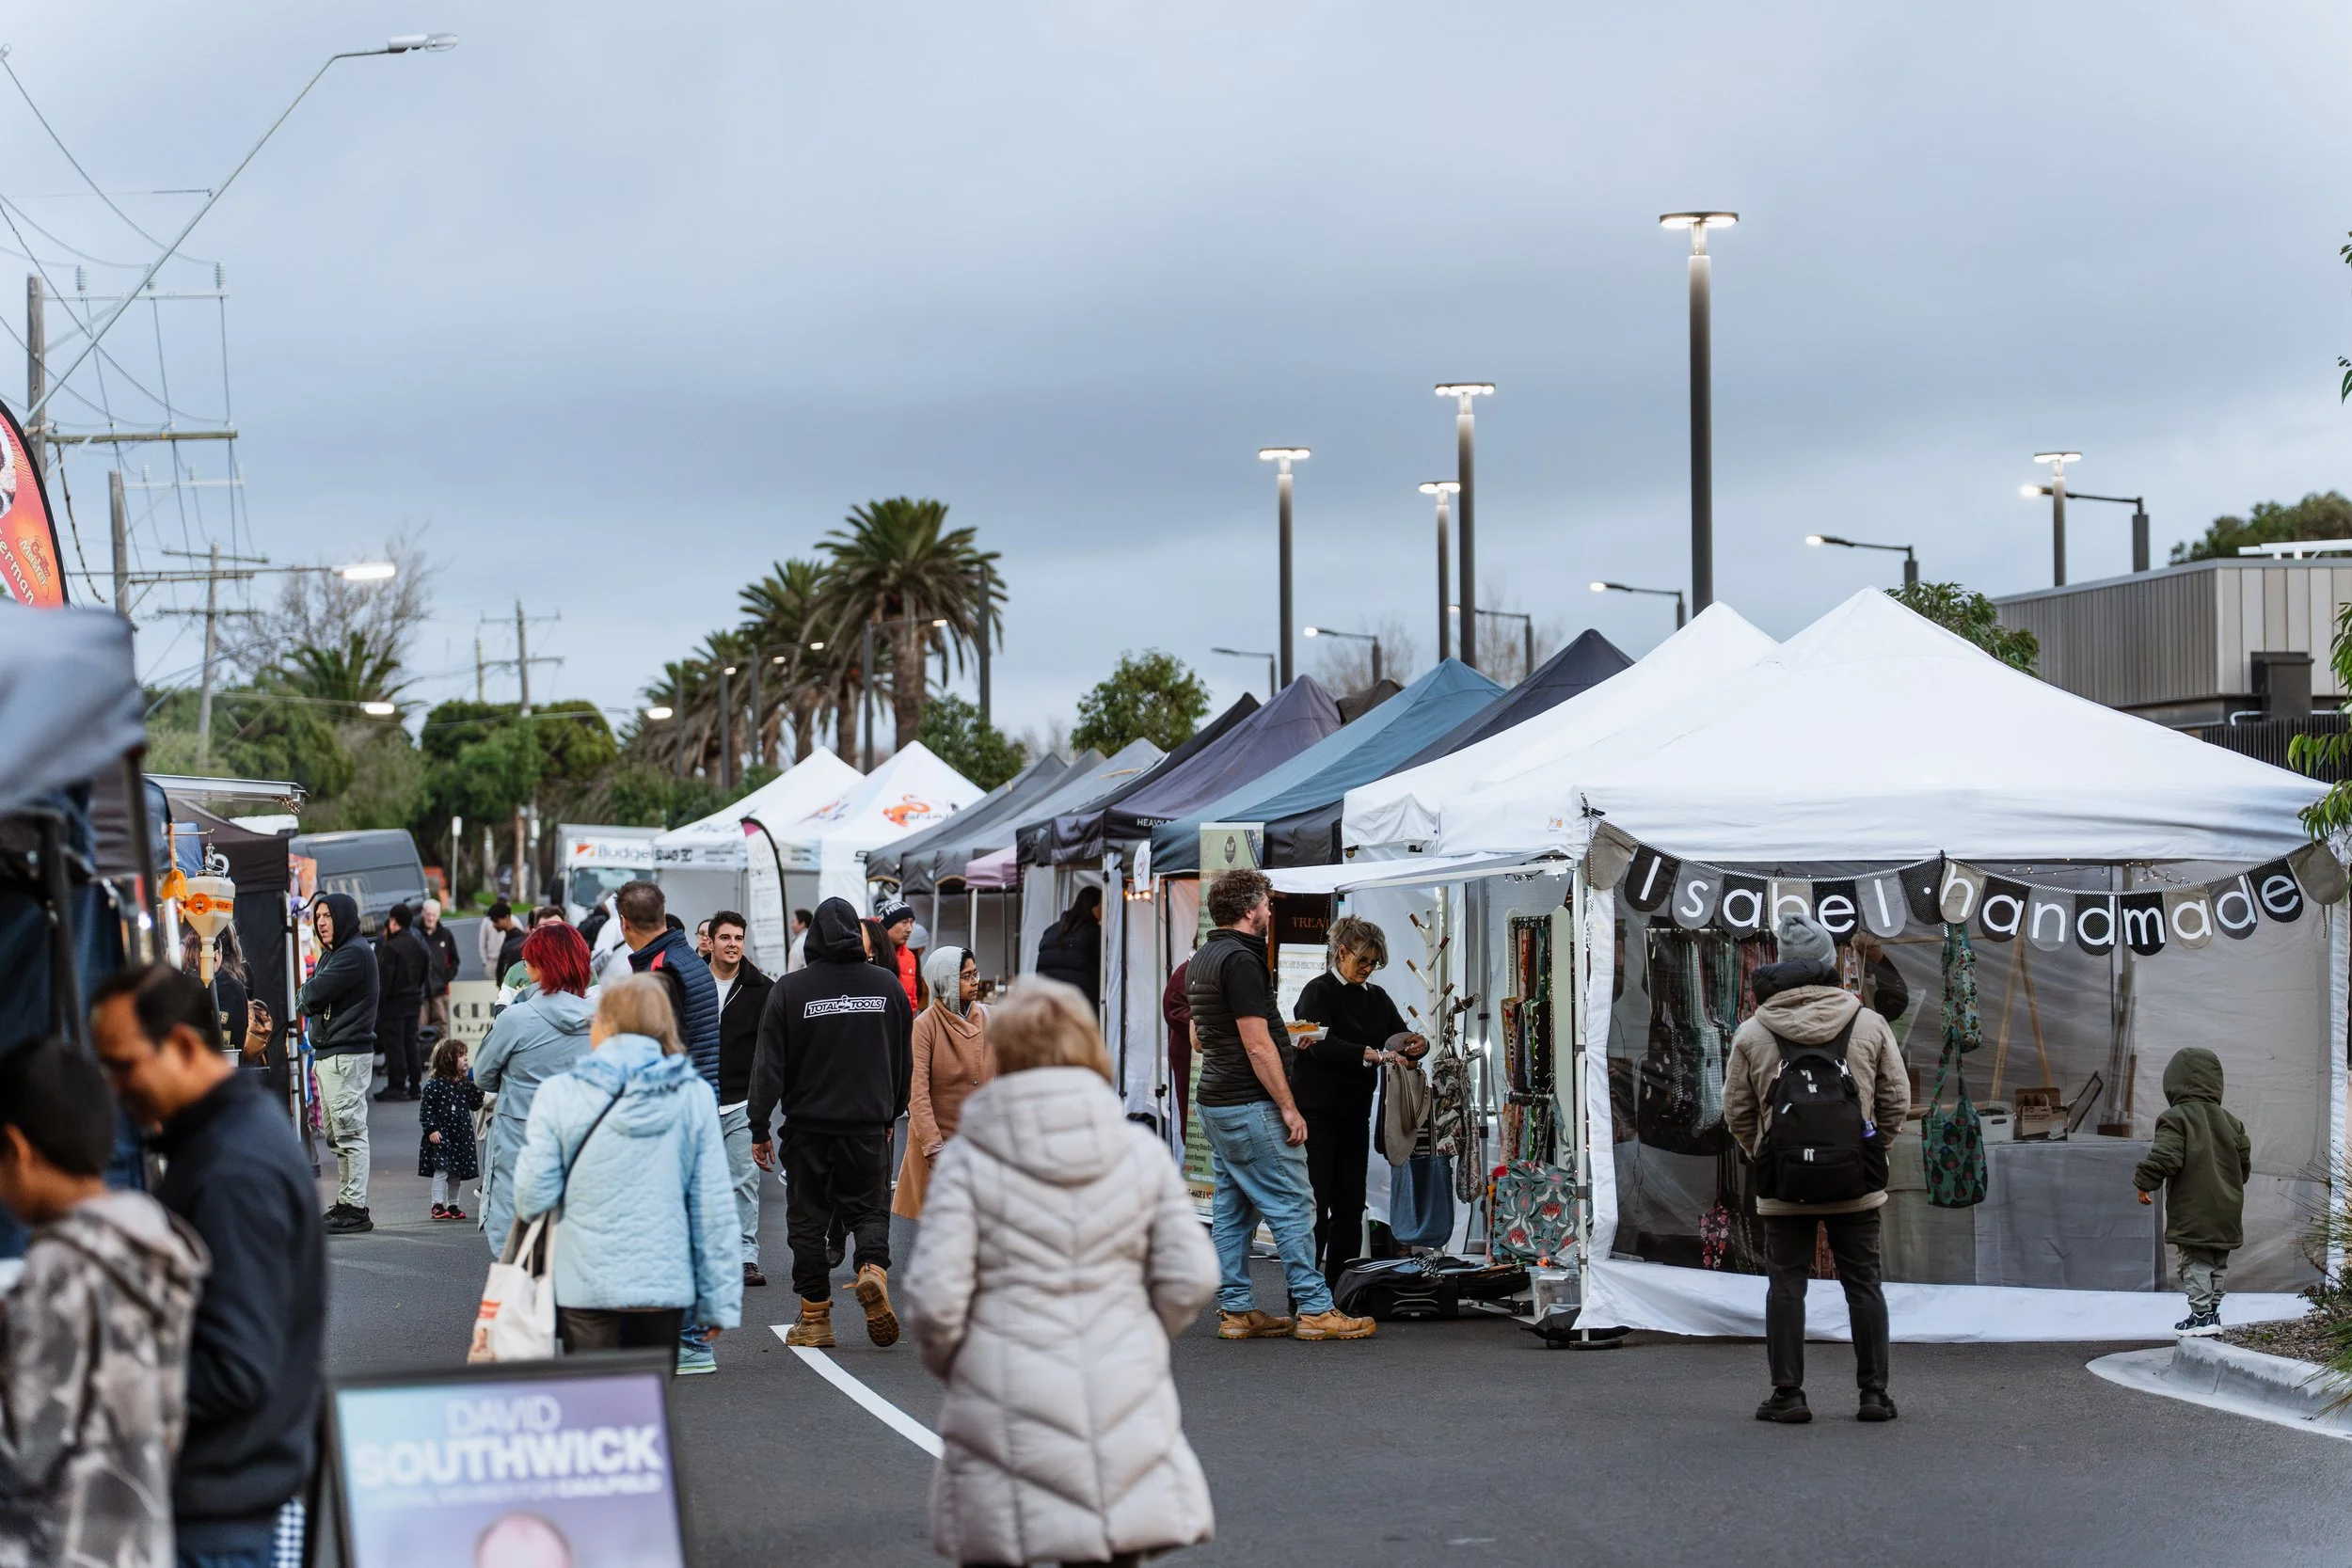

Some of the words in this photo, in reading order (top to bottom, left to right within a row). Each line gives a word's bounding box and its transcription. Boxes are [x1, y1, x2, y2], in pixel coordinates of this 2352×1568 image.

[0, 529, 34, 605] erman
[1640, 855, 1890, 933] Isabel
[1939, 863, 2300, 945] handmade
[809, 1001, 838, 1015] TOTAL
[850, 999, 883, 1010] TOOLS
[444, 1394, 563, 1436] DAVID
[351, 1422, 664, 1489] SOUTHWICK
